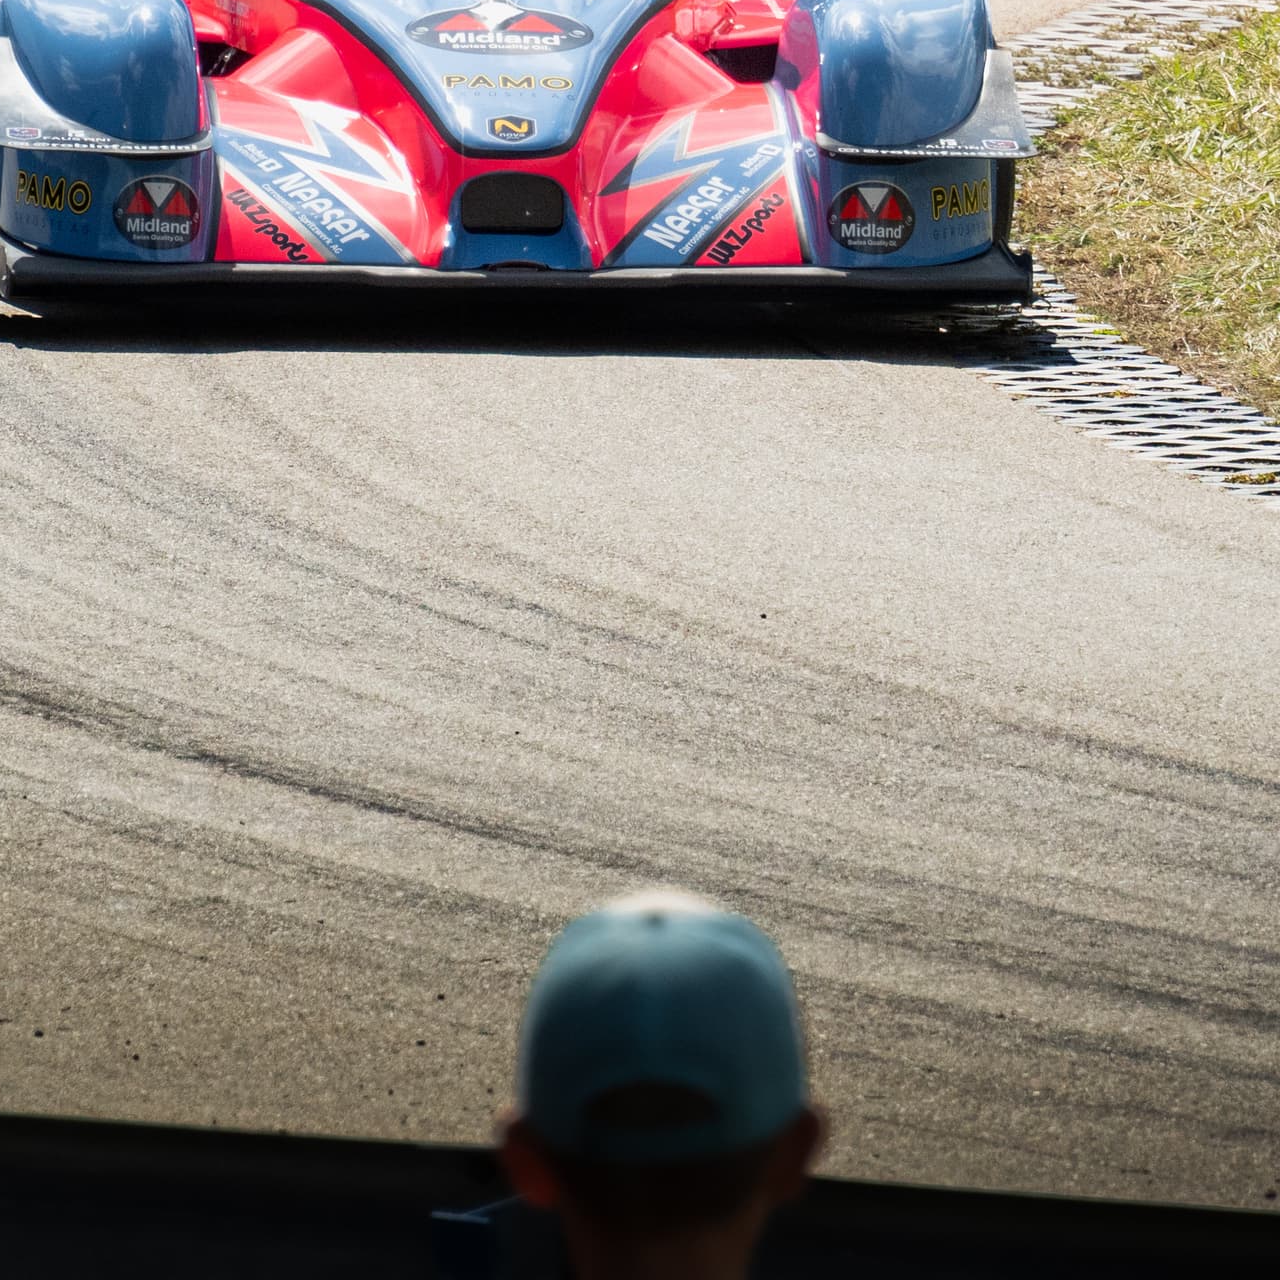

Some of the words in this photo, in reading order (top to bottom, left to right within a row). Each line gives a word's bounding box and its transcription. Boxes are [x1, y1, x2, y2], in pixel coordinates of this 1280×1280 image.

[438, 32, 561, 47] Midland
[441, 73, 573, 91] PAMO
[16, 170, 92, 215] PAMO
[127, 218, 190, 234] Midland
[841, 223, 902, 239] Midland
